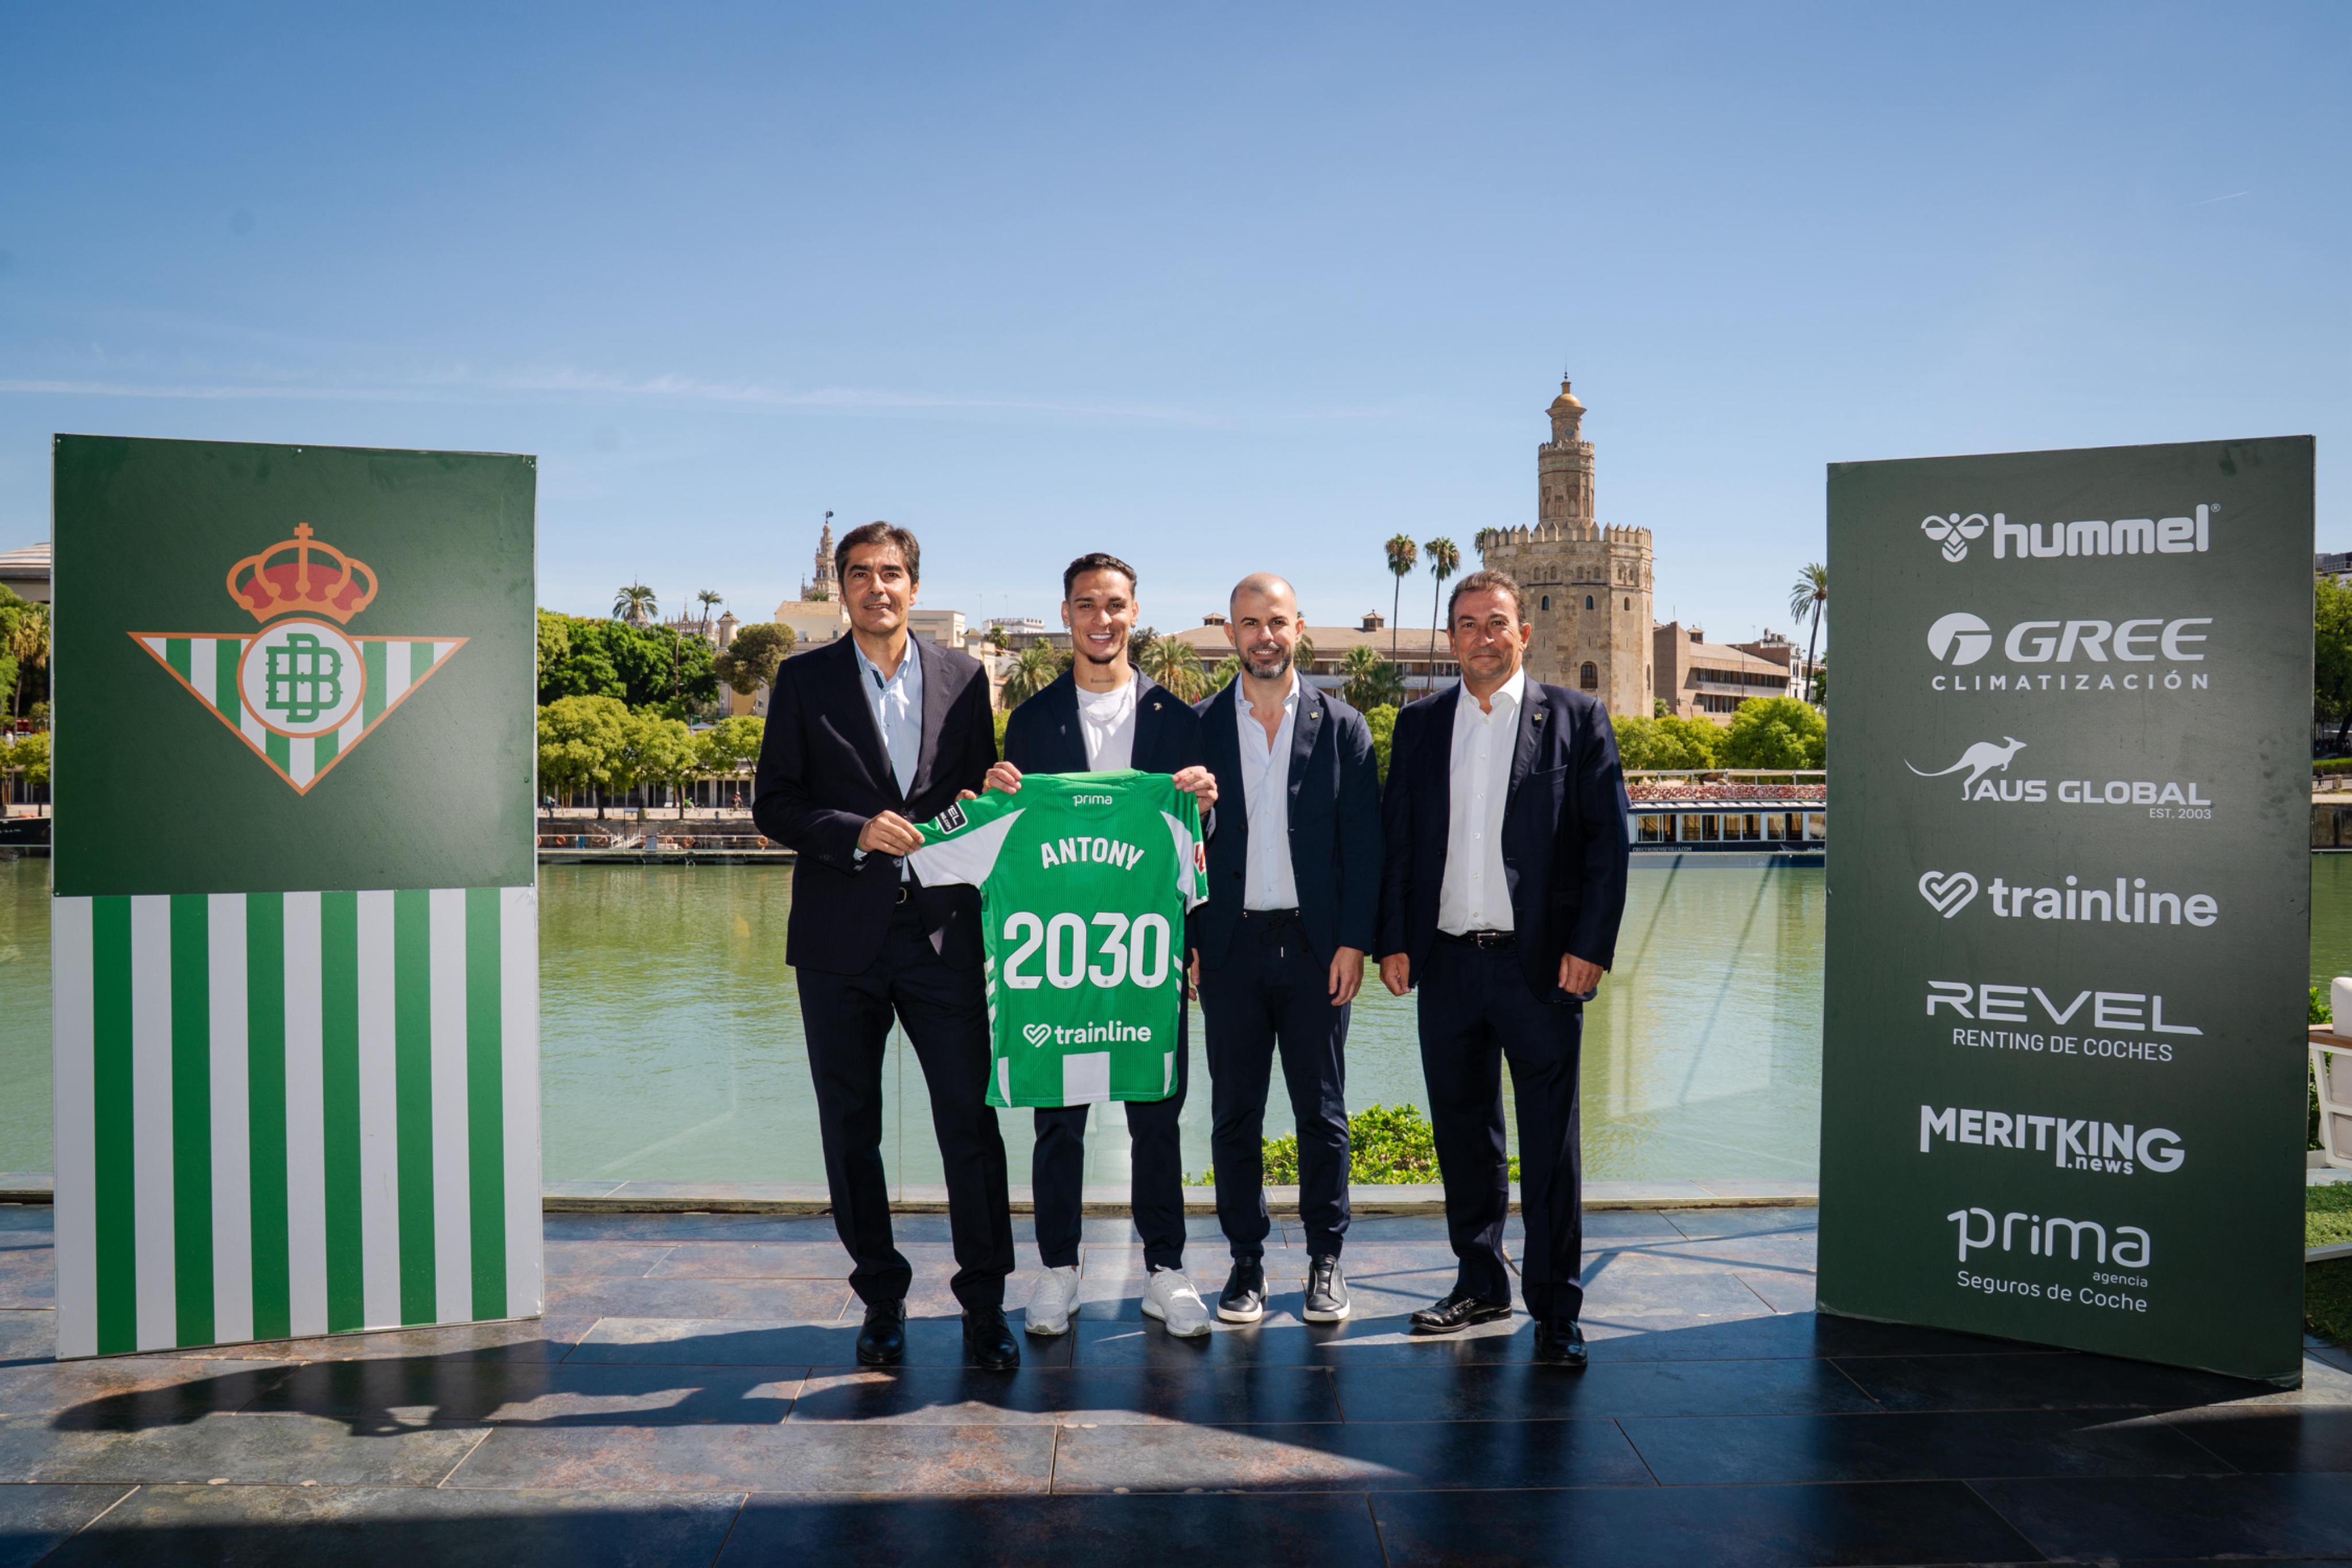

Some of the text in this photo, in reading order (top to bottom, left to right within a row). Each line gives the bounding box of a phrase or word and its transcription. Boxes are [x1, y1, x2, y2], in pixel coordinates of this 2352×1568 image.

[2004, 617, 2213, 663] GREE
[1931, 669, 2208, 691] CLIMATIZACIÓN
[1073, 795, 1113, 807] prima
[1973, 779, 2211, 806] AUS GLOBAL
[2149, 807, 2212, 820] EST. 2003
[1040, 837, 1145, 871] ANTONY
[1987, 874, 2218, 927] trainline
[1003, 911, 1171, 989] 2030
[1926, 979, 2204, 1036] REVEL
[1054, 1020, 1152, 1045] trainline
[1953, 1028, 2173, 1062] RENTING DE COCHES
[1920, 1105, 2185, 1173] MERITKING
[2067, 1156, 2134, 1175] .news
[1947, 1207, 2150, 1268] prima
[1957, 1270, 2148, 1313] Seguros de Coche
[2092, 1272, 2149, 1288] agencia
